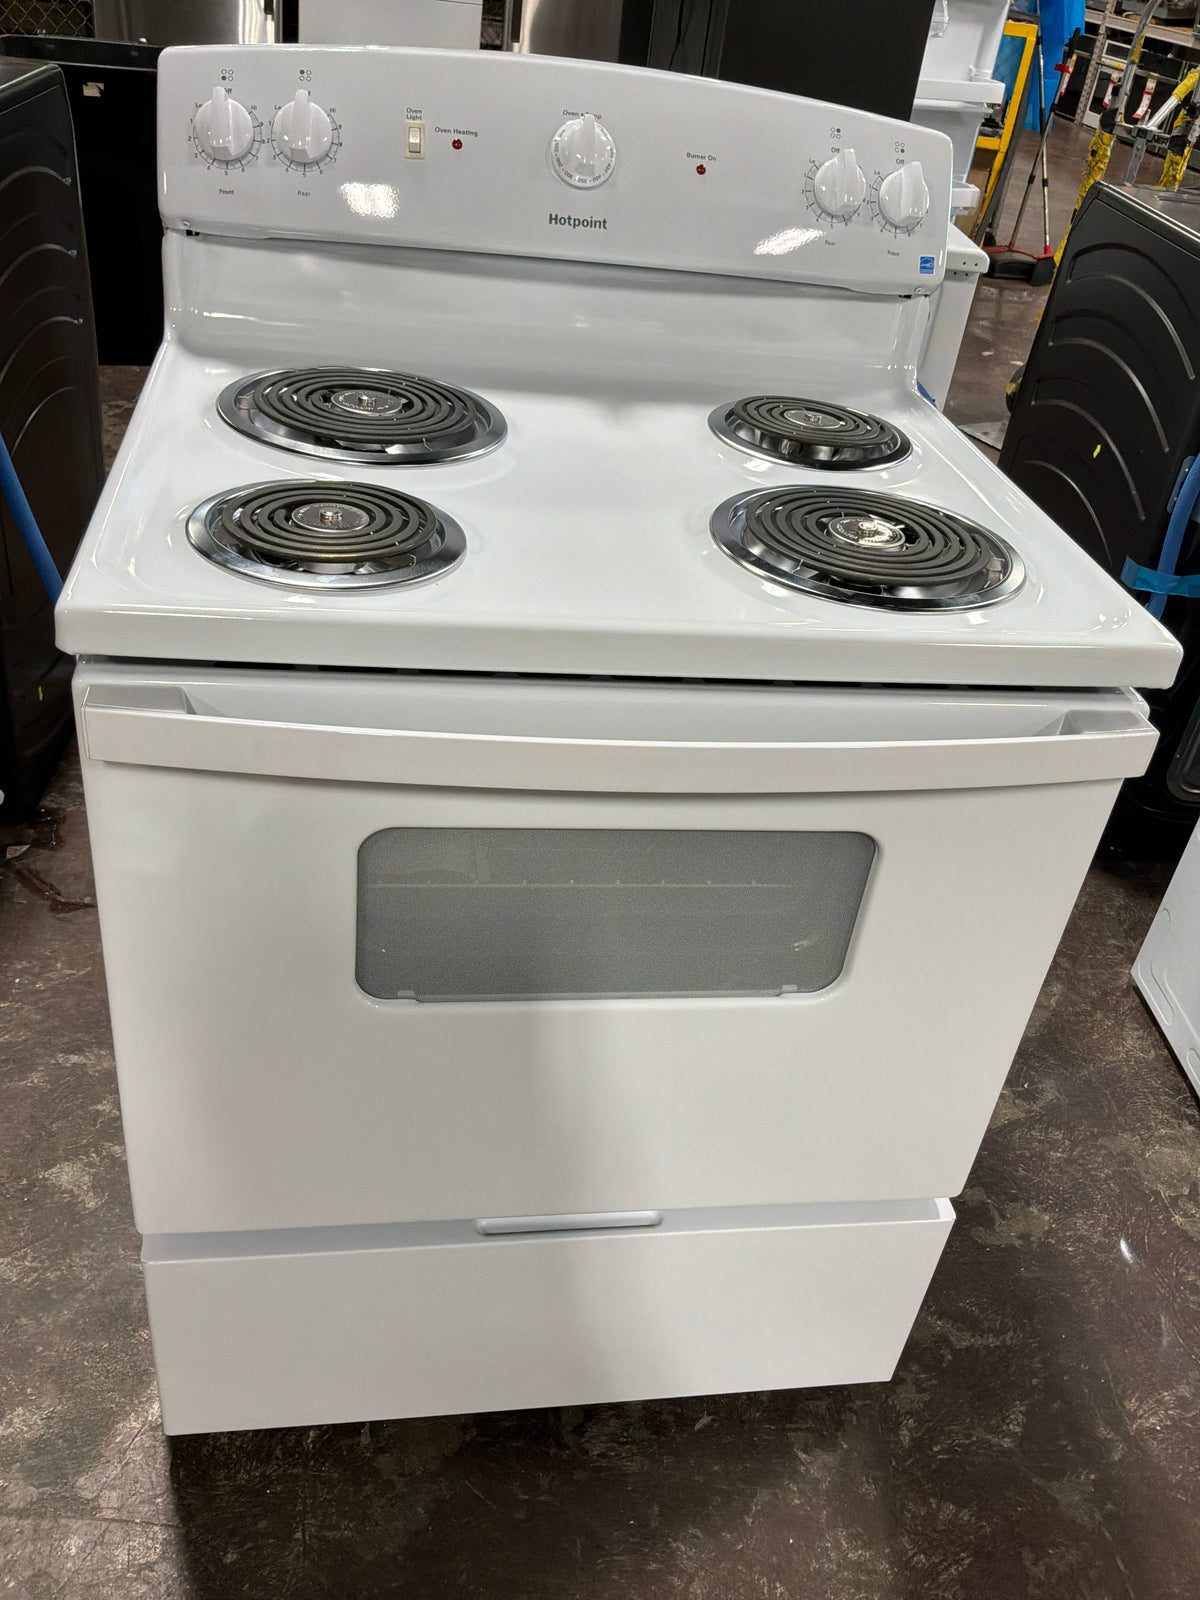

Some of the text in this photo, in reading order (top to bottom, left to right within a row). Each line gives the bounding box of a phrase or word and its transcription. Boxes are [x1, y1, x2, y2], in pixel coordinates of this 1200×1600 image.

[562, 109, 579, 117] Oven
[434, 126, 478, 137] Oven Heating
[686, 151, 706, 160] Burner
[548, 213, 608, 230] Hotpoint
